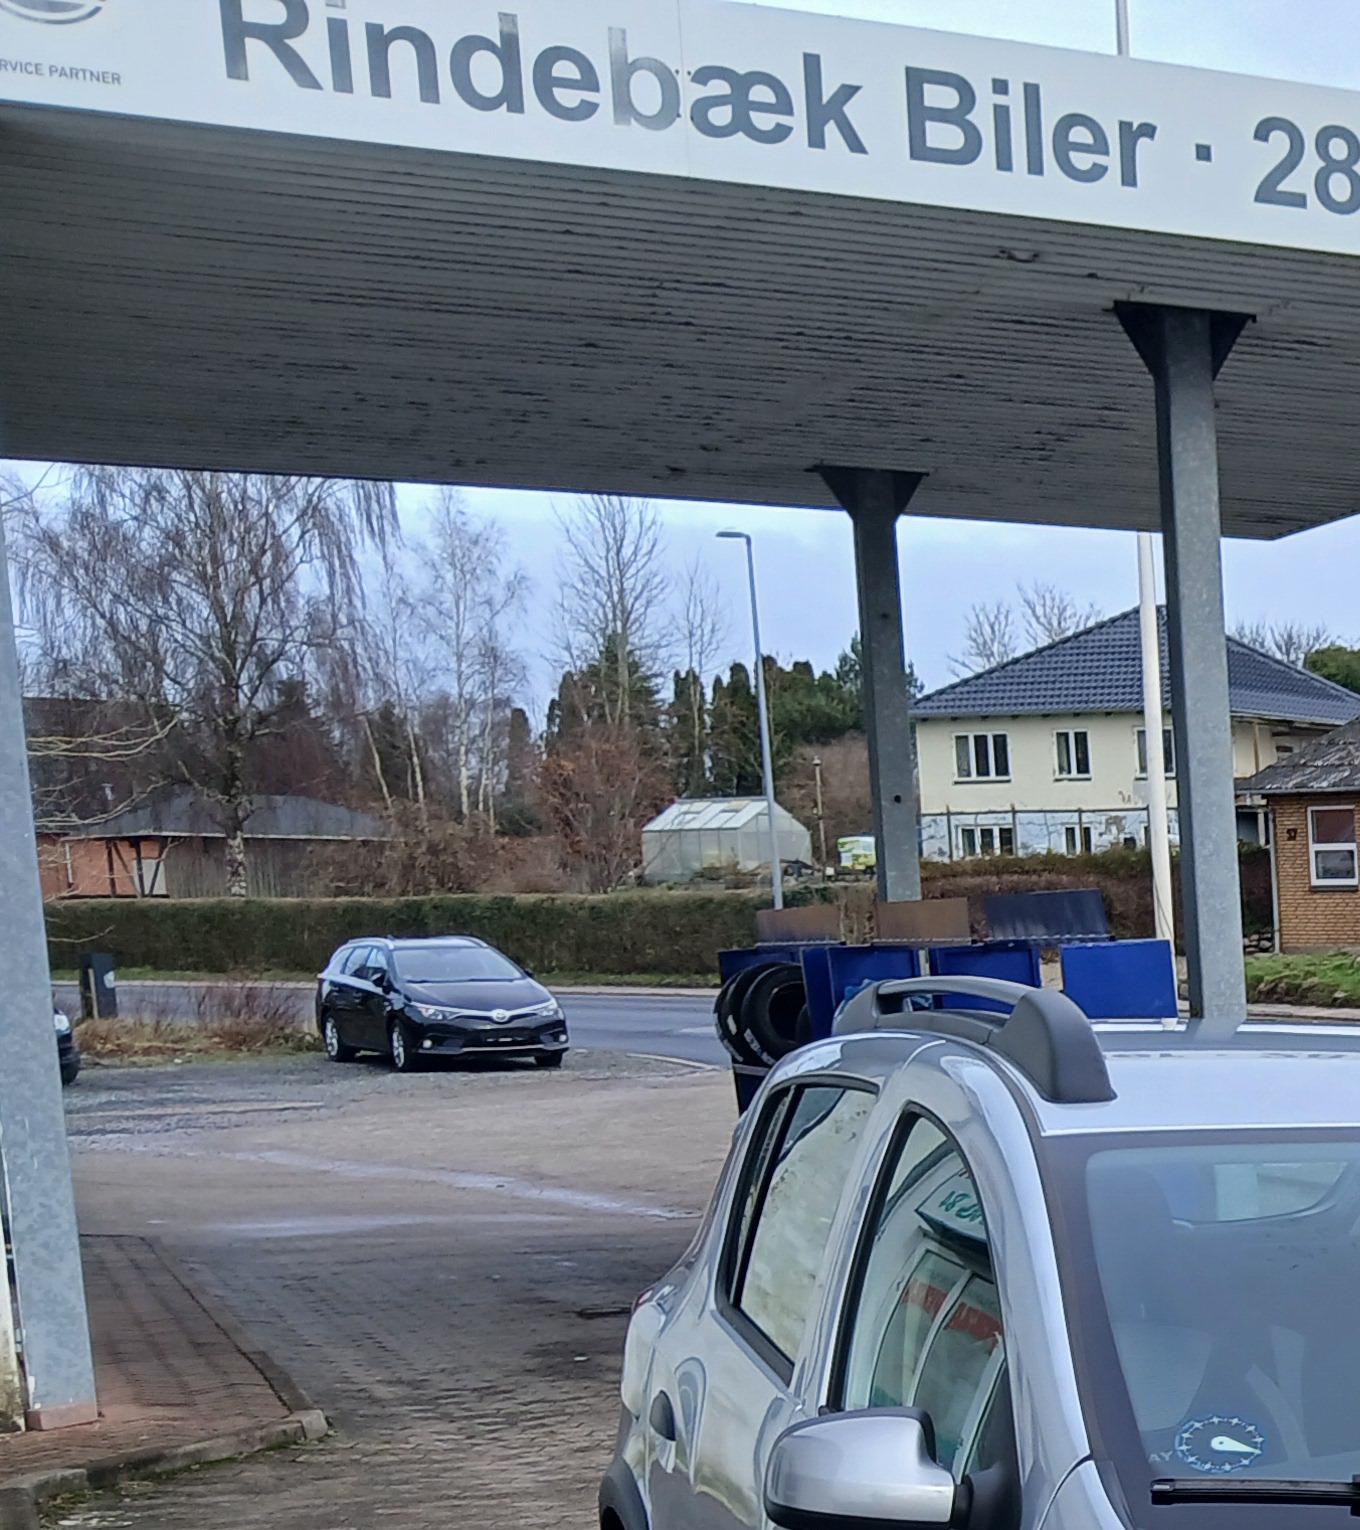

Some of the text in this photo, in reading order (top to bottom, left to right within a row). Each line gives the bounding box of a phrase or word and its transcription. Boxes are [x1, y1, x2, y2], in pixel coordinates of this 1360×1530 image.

[49, 65, 122, 86] PARTNER
[219, 0, 868, 156] Rindebæk
[905, 65, 1157, 188] Biler
